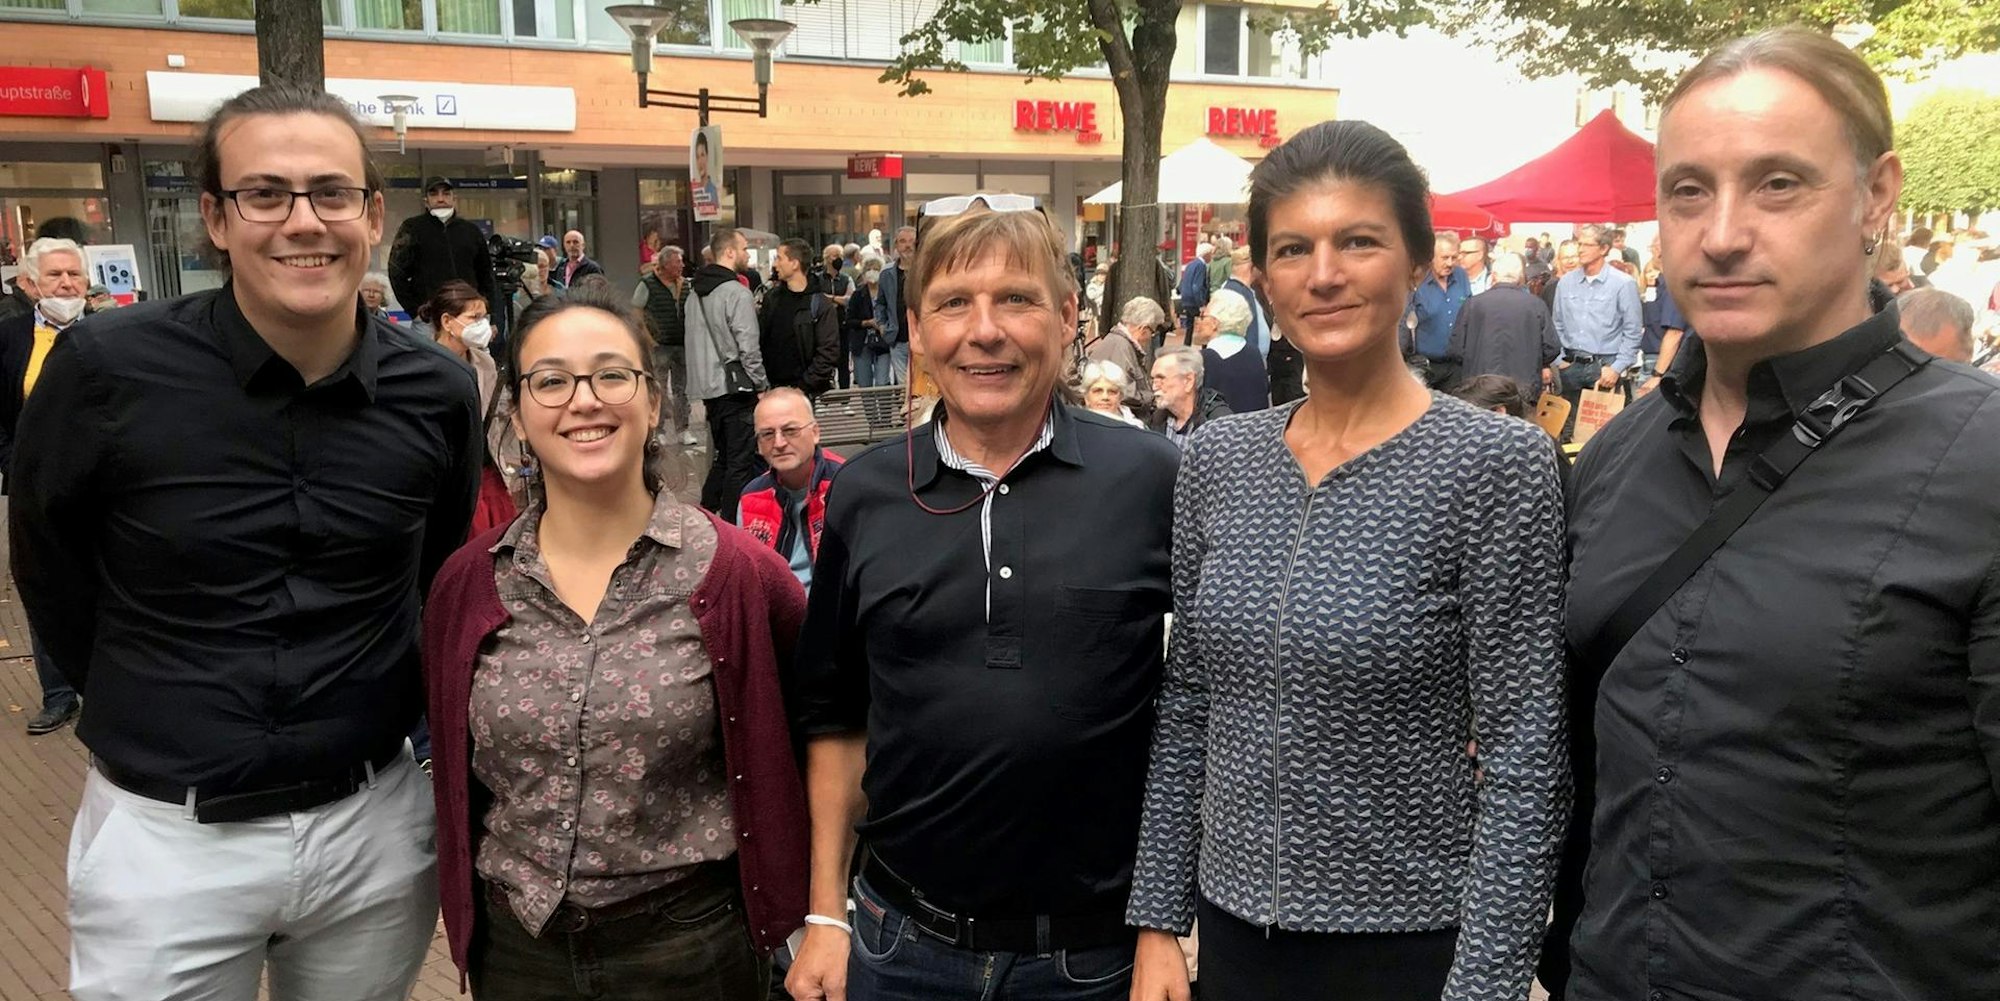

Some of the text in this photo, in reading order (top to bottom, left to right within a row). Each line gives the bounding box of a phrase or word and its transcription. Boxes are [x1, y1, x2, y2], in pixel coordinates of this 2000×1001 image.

[0, 85, 72, 101] uptstraße
[383, 100, 425, 115] Bnk
[1013, 100, 1097, 131] REWE
[1205, 107, 1278, 135] REWE
[854, 158, 878, 172] REWE
